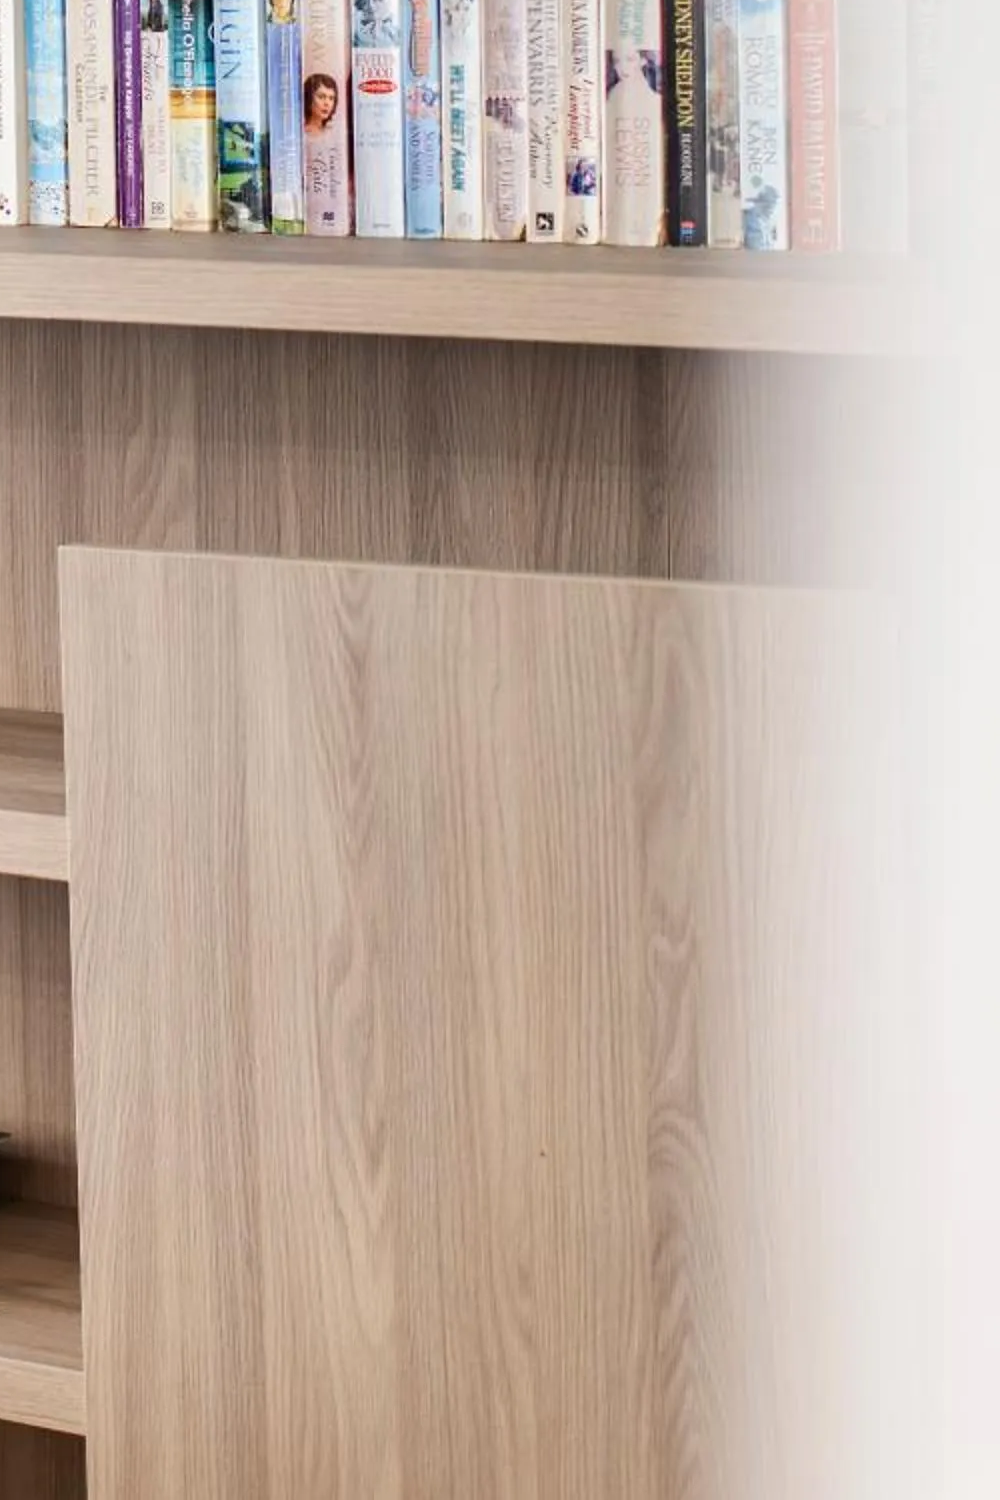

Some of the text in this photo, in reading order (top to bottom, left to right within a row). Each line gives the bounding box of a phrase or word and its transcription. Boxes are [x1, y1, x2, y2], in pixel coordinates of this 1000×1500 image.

[675, 48, 696, 128] SHELDON
[614, 118, 633, 188] LEWIS
[633, 118, 649, 187] SUSAN
[747, 119, 764, 174] KANE
